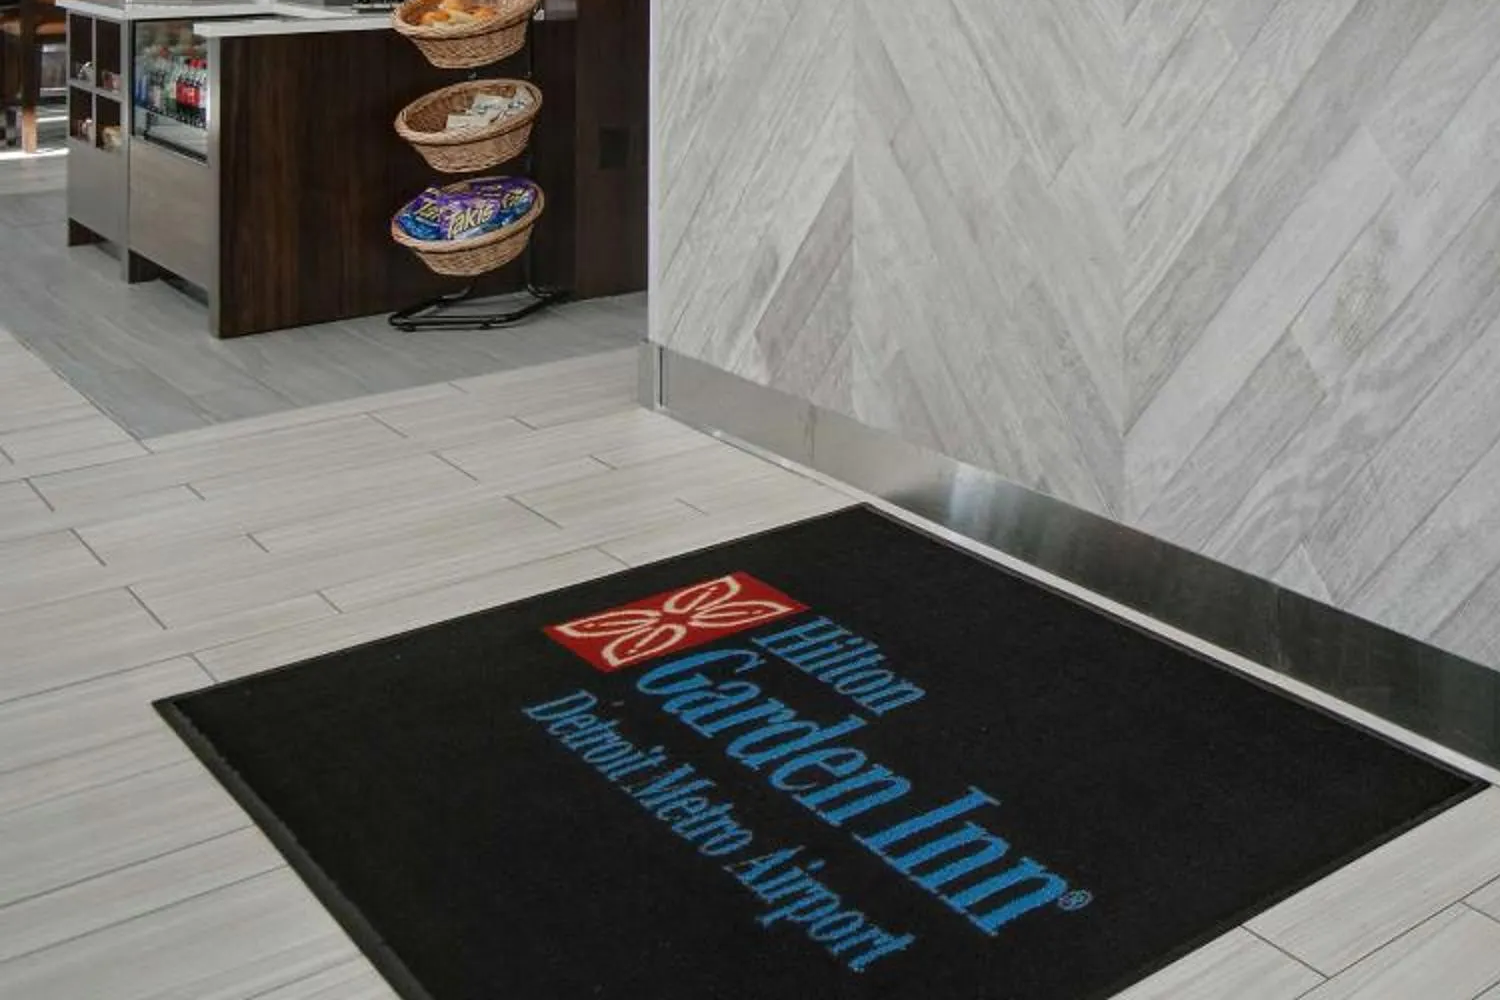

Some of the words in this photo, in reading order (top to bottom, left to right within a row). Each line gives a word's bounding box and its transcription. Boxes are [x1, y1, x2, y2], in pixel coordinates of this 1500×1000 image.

[446, 205, 494, 240] Takis
[751, 615, 926, 715] Hilton
[636, 648, 912, 826] Garden
[521, 689, 666, 782] Detroit
[619, 763, 754, 855] Metro
[723, 845, 915, 972] Airport
